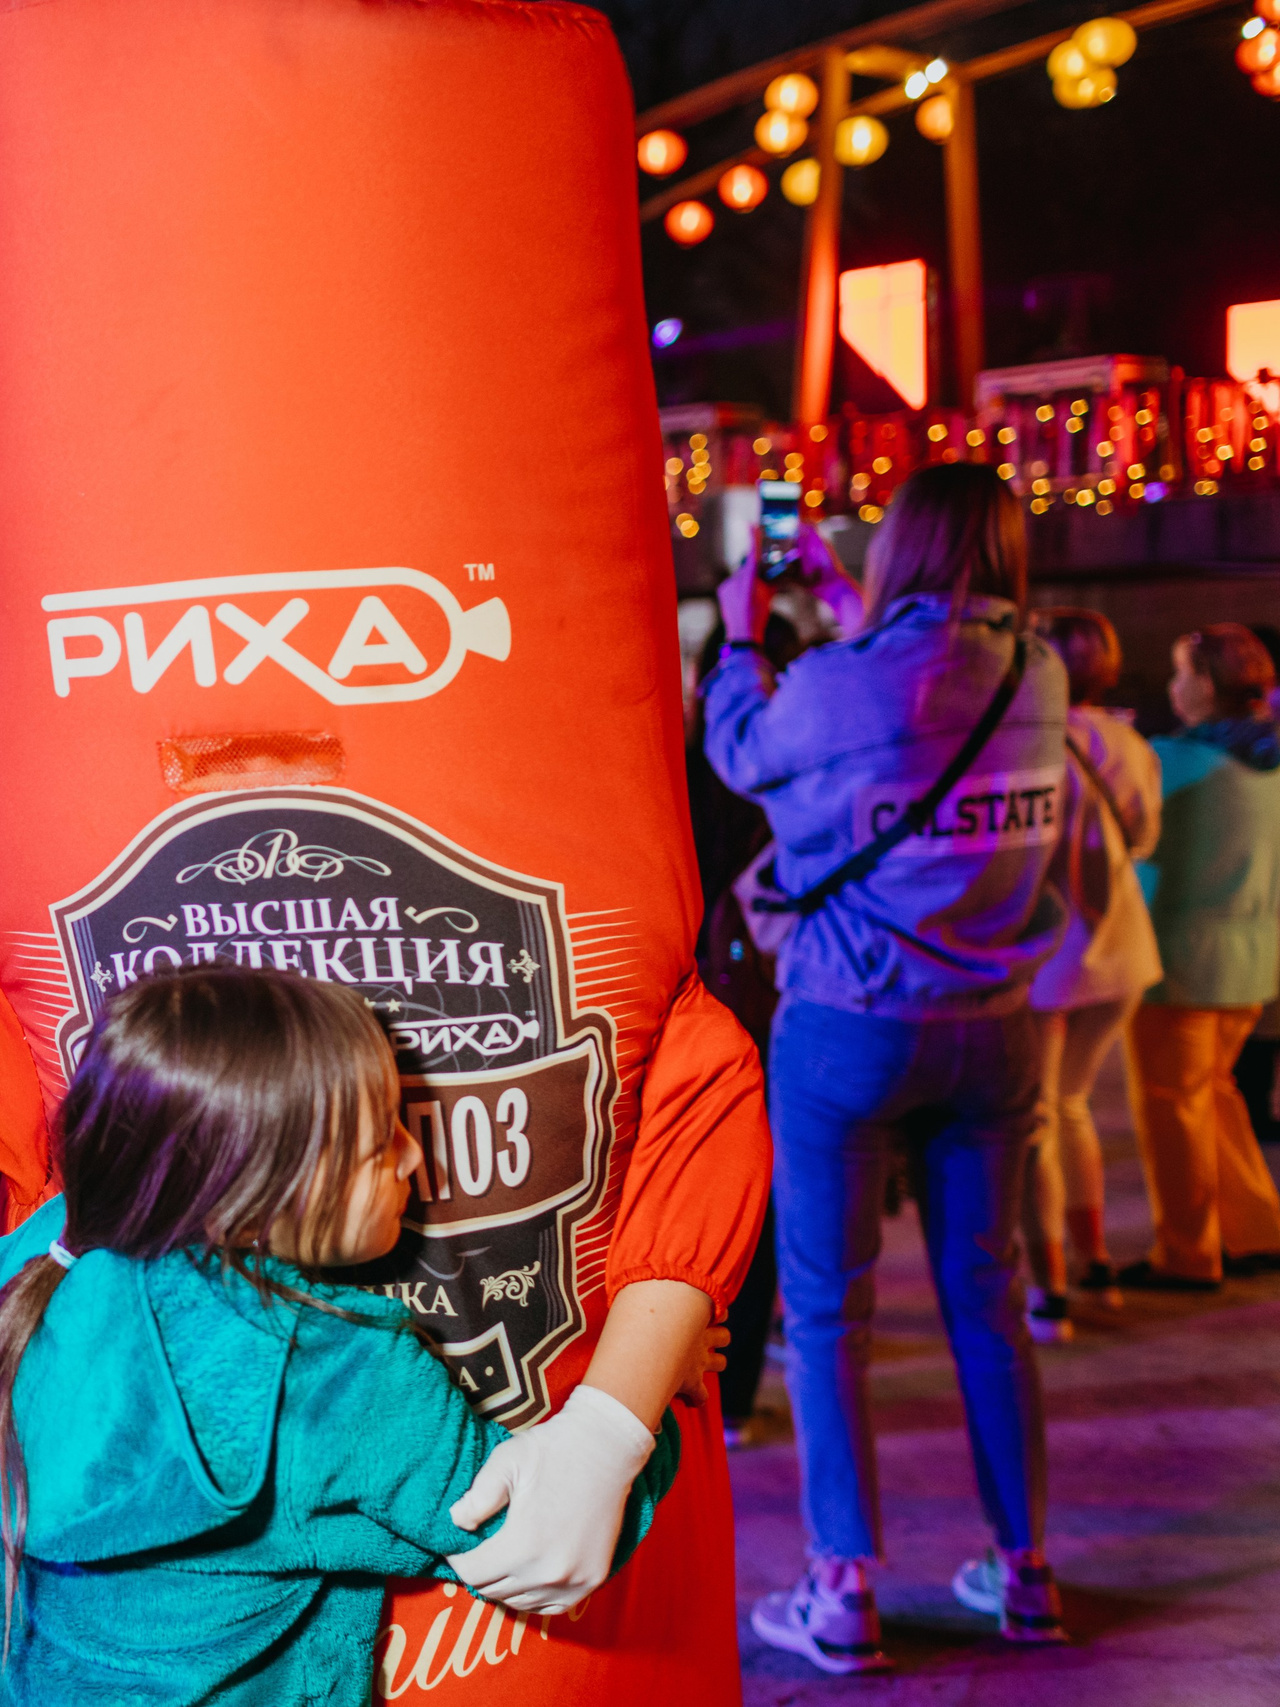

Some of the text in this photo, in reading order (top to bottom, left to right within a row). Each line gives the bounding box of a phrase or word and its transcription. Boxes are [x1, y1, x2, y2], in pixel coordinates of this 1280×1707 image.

[463, 563, 496, 582] TM
[44, 588, 436, 706] РИХА
[180, 897, 403, 947] ВЫСШАЯ
